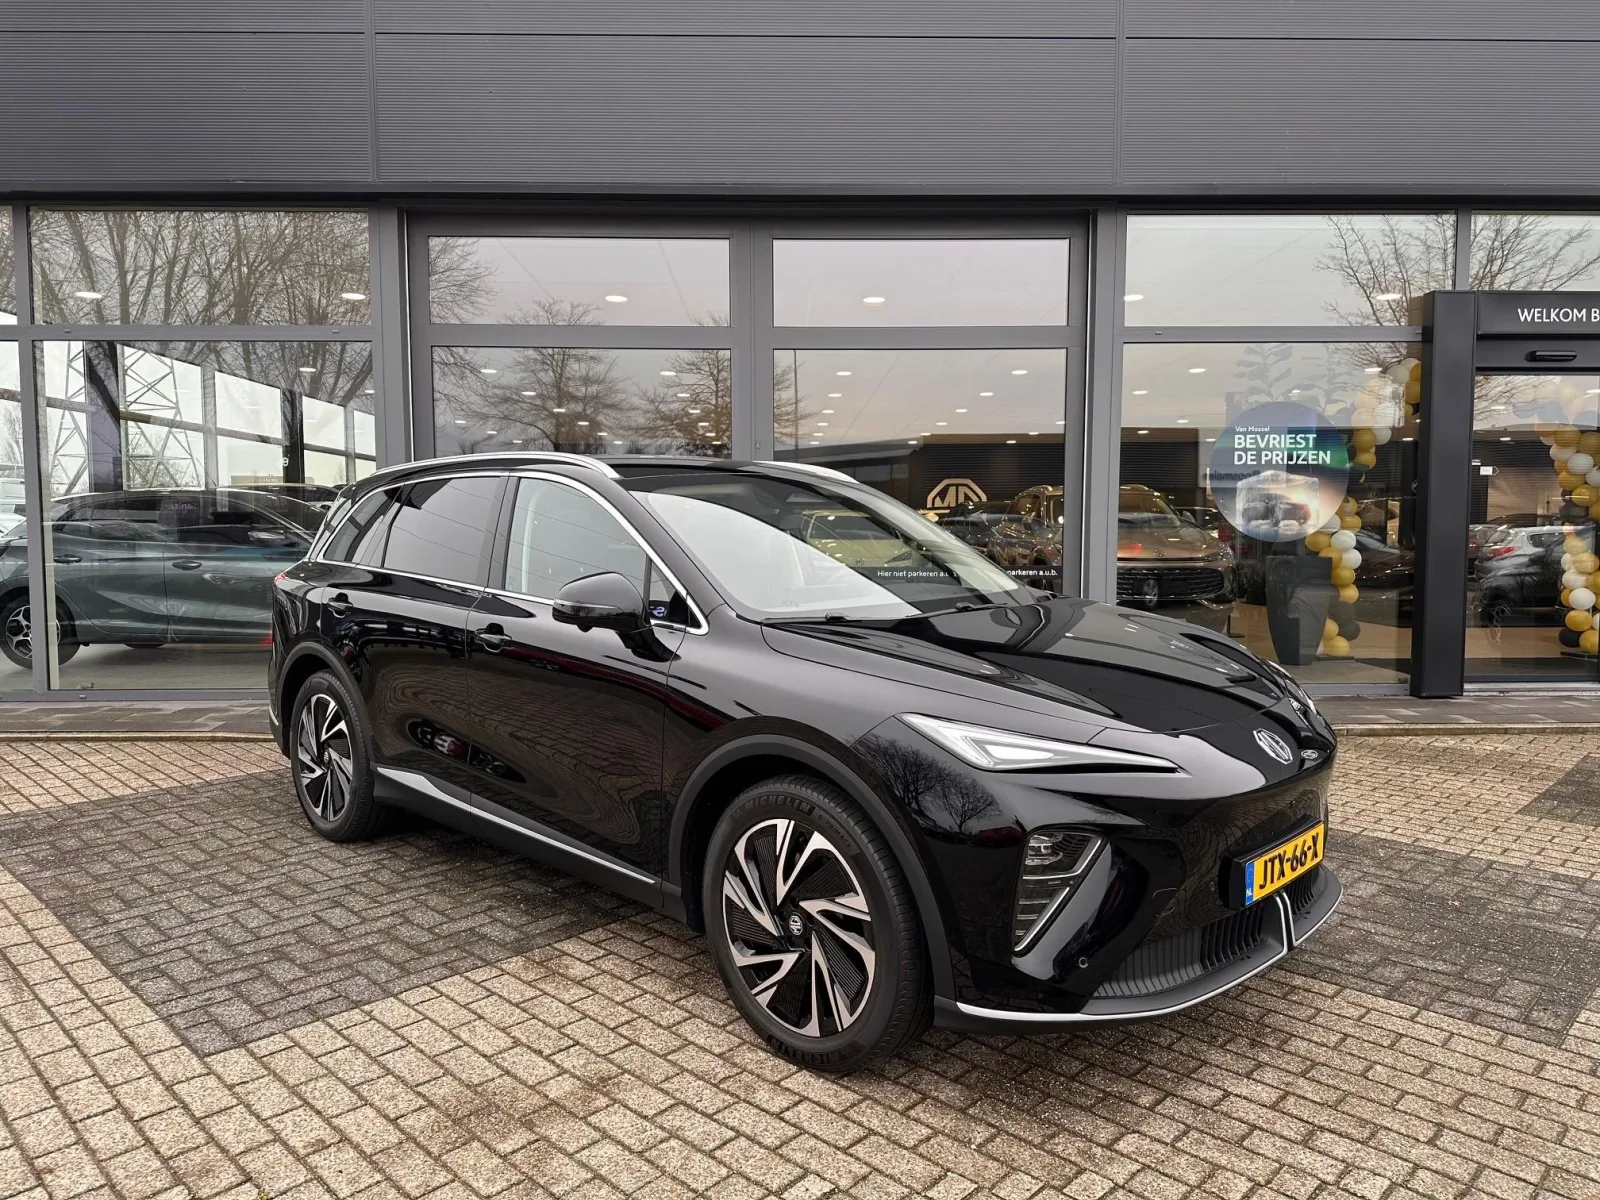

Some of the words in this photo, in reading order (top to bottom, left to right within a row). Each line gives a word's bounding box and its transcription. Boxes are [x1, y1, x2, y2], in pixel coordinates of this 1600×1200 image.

[1517, 308, 1587, 322] WELKOM
[1591, 308, 1600, 322] B
[1234, 434, 1317, 448] BEVRIEST
[1233, 450, 1257, 465] DE
[1261, 450, 1331, 465] PRIJZEN
[908, 570, 938, 578] parkeren
[1259, 832, 1319, 890] JTX-66-X
[1246, 888, 1253, 897] NL
